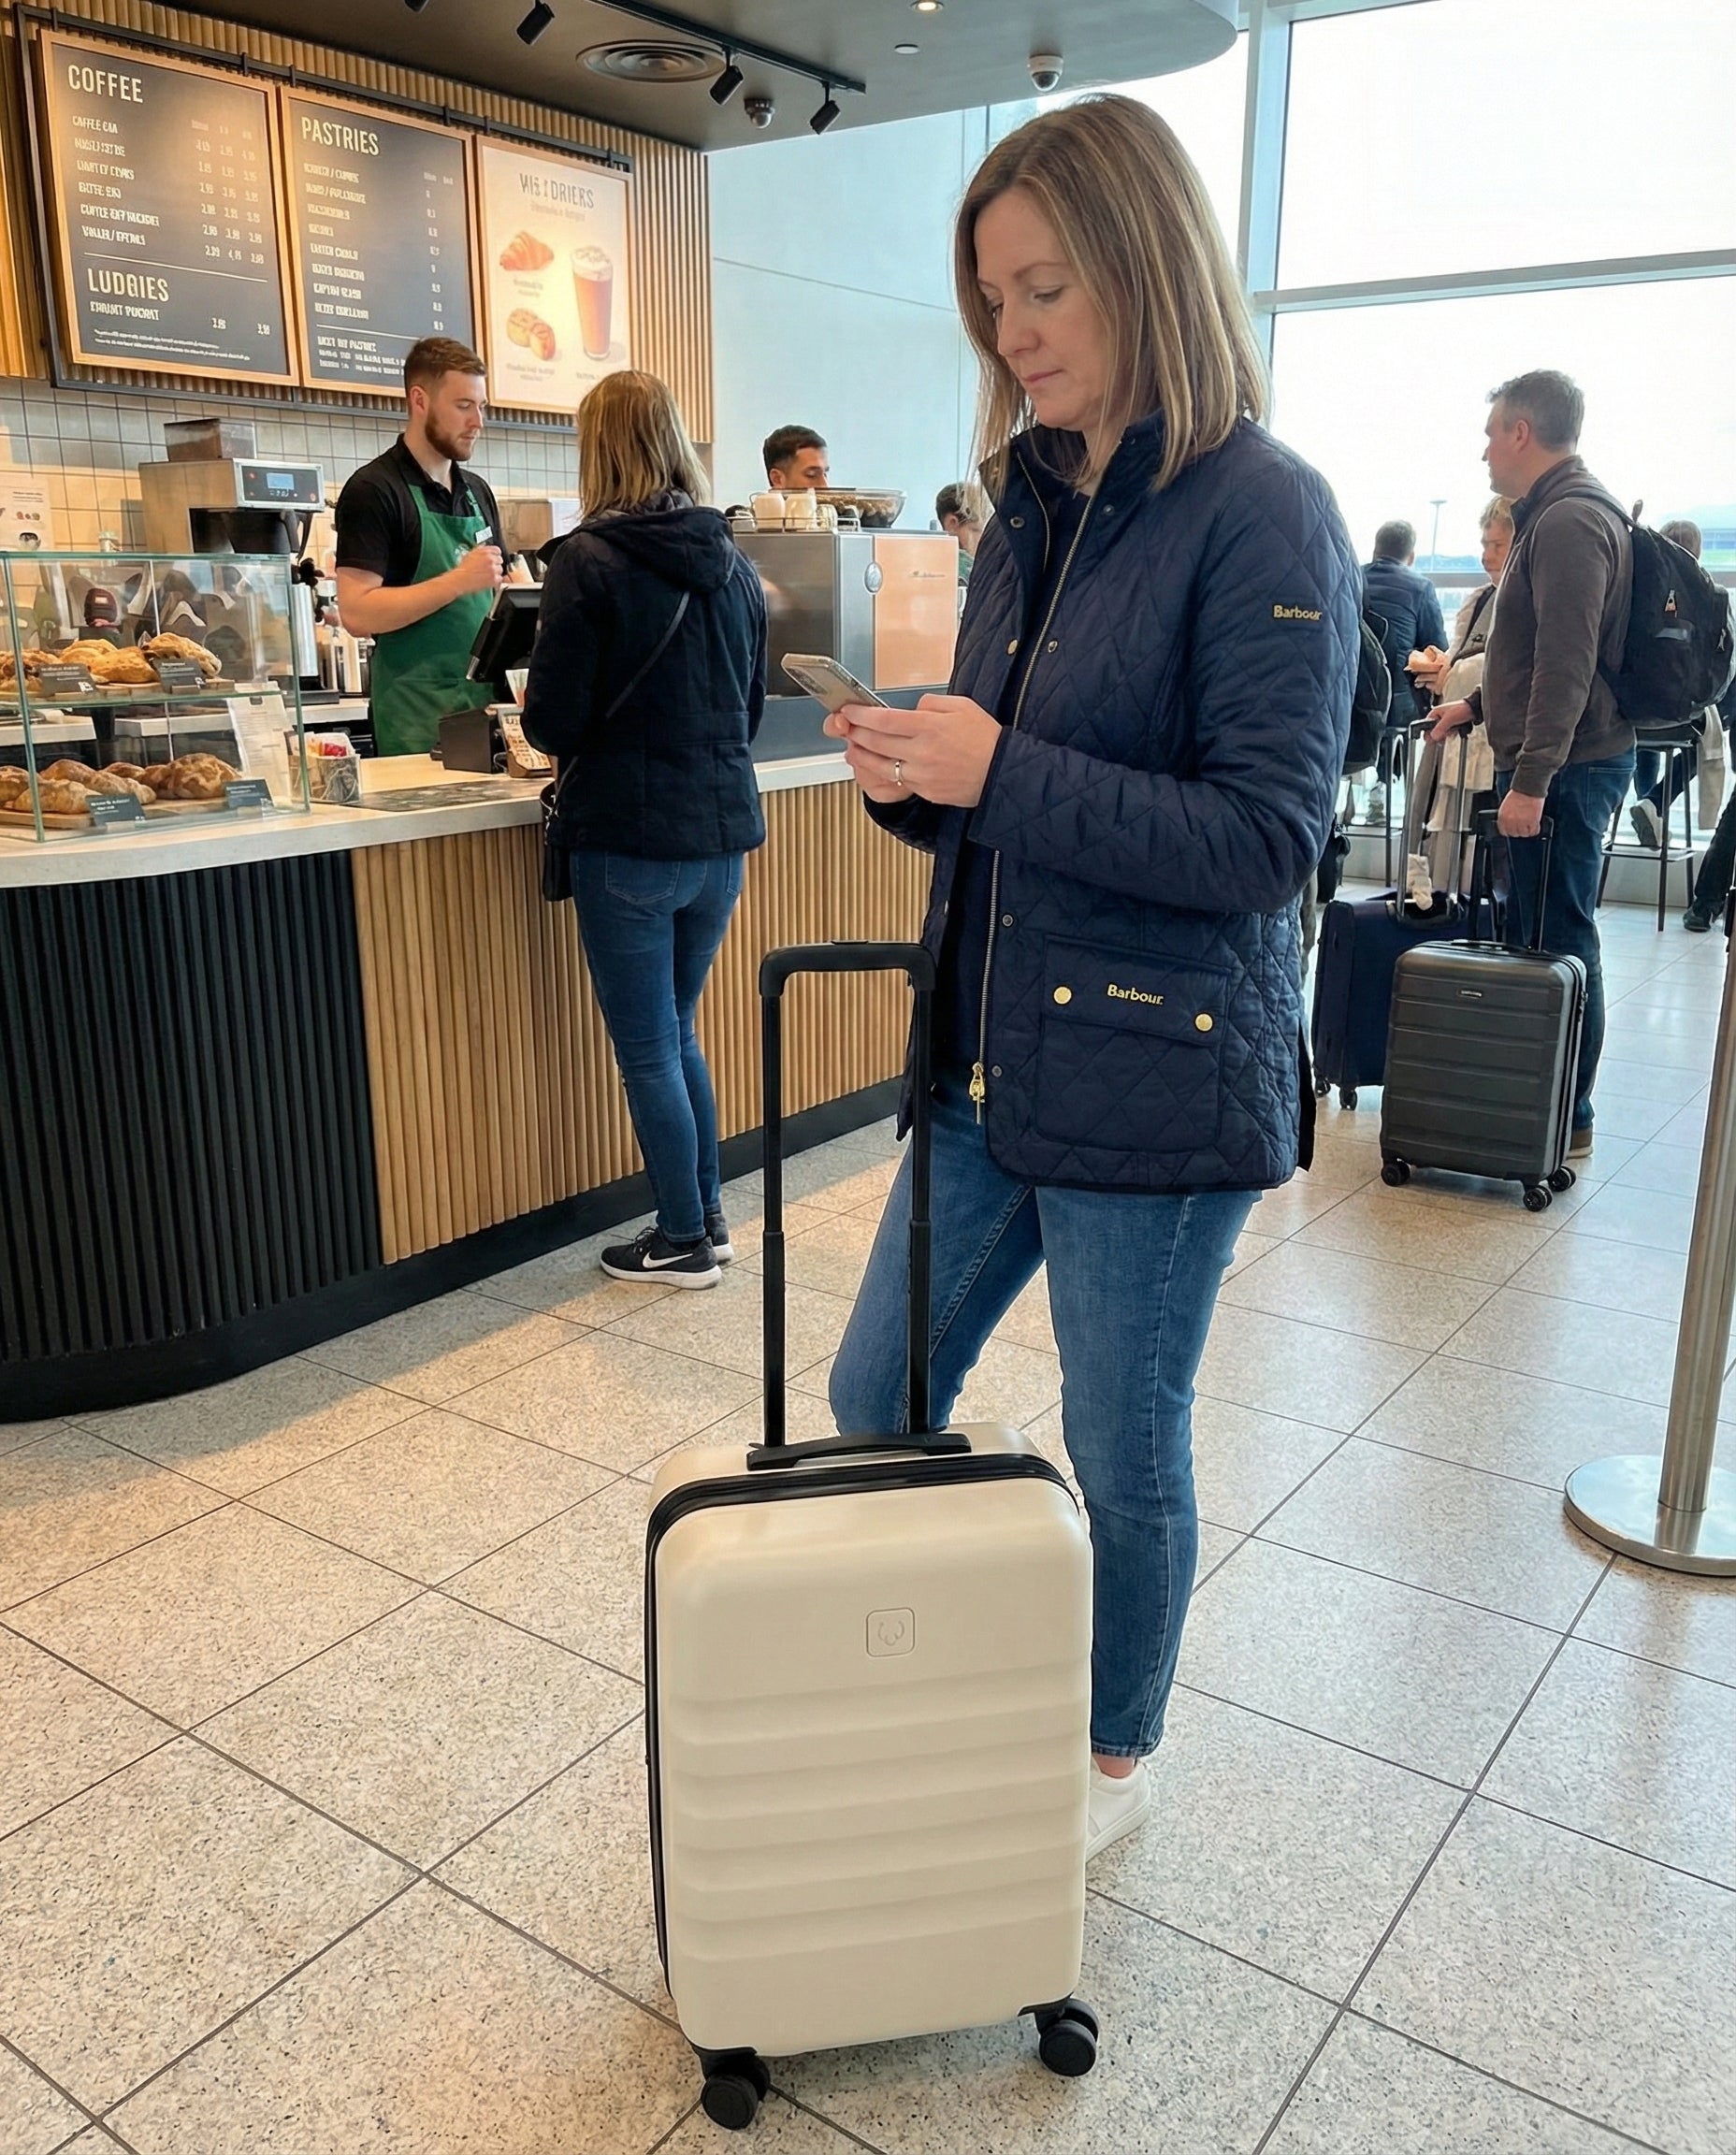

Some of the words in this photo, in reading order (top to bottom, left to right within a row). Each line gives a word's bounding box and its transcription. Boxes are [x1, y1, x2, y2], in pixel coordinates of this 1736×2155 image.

[68, 65, 143, 103] COFFEE
[301, 116, 379, 156] PASTRIES
[1273, 604, 1323, 621] Barbour
